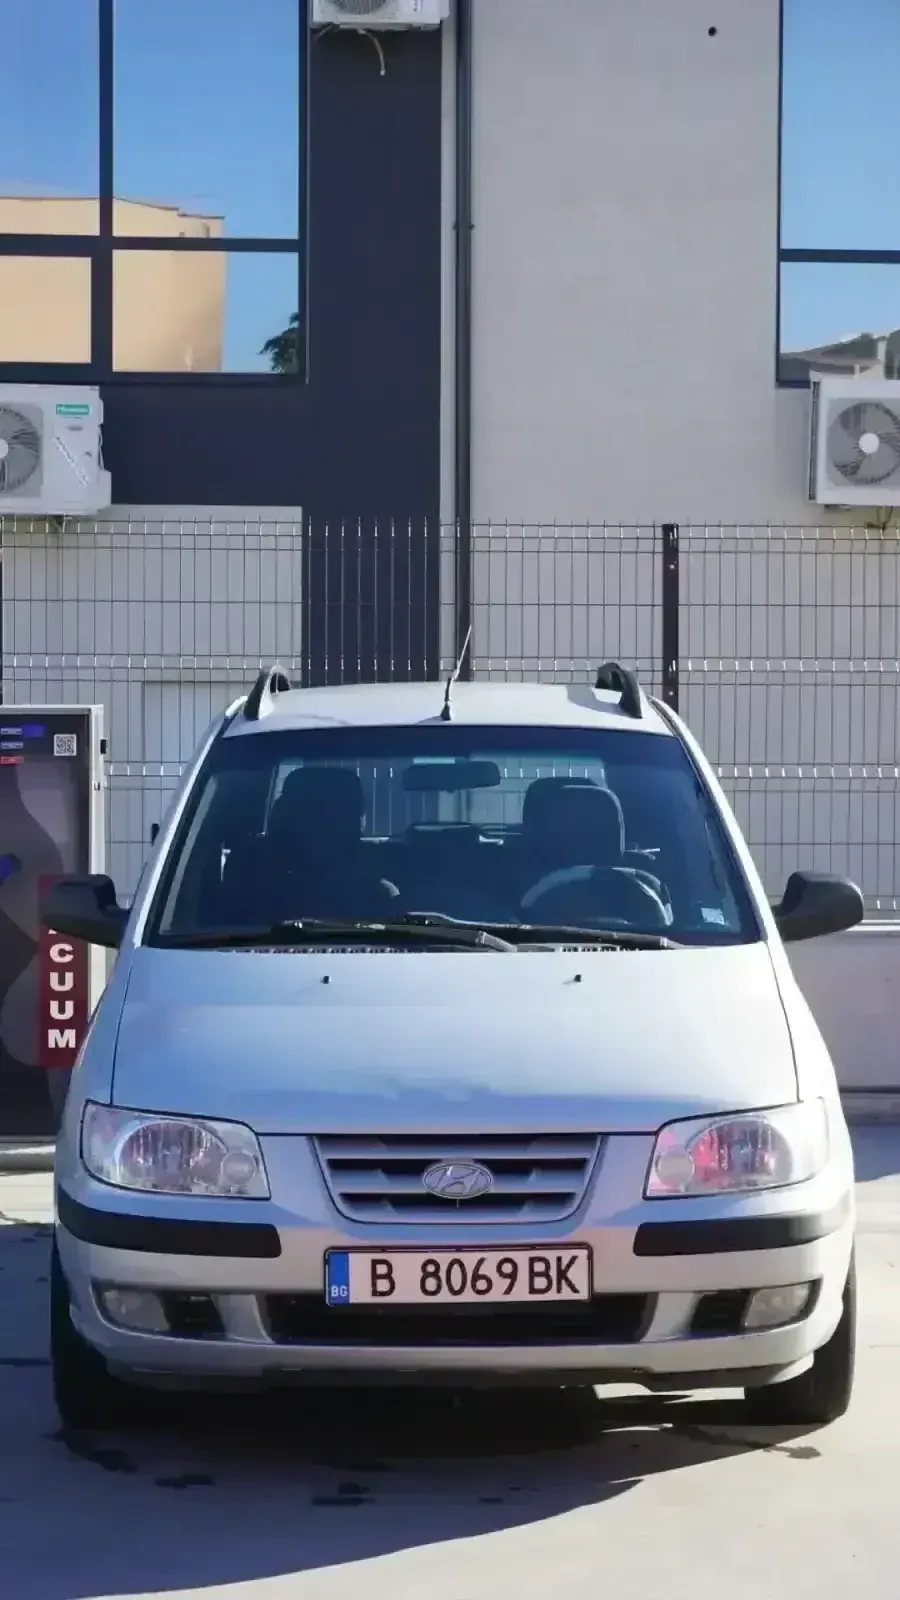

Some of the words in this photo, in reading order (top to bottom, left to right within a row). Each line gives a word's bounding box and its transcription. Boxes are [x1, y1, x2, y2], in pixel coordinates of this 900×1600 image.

[48, 928, 76, 1048] CUUM
[331, 1285, 348, 1297] BG
[370, 1258, 396, 1297] B
[419, 1257, 519, 1297] 8069
[527, 1255, 580, 1295] BK
